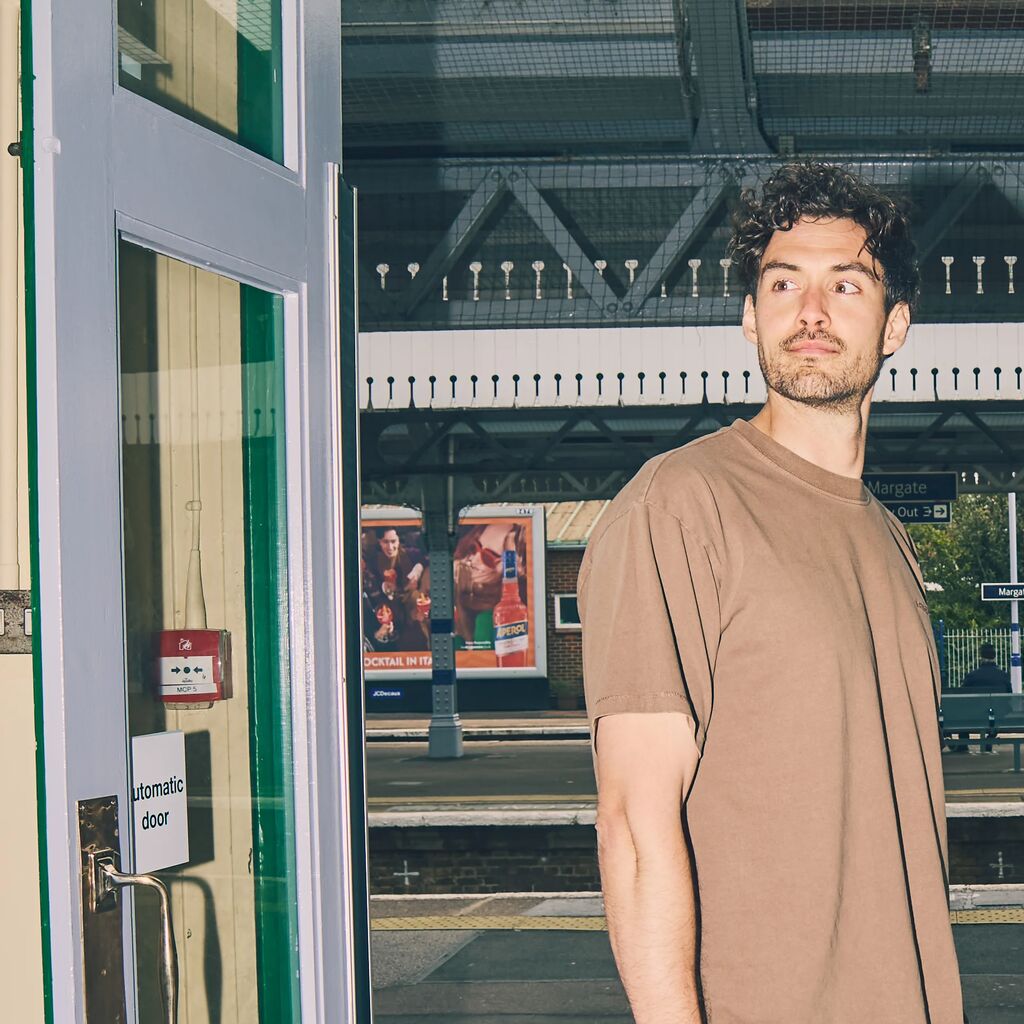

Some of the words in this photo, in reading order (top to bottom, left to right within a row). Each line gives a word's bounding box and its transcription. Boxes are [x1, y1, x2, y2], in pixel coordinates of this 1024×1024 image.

[868, 481, 927, 497] Margate
[897, 506, 918, 517] Out
[407, 656, 417, 666] IN
[132, 775, 184, 802] utomatic
[142, 811, 169, 830] door
